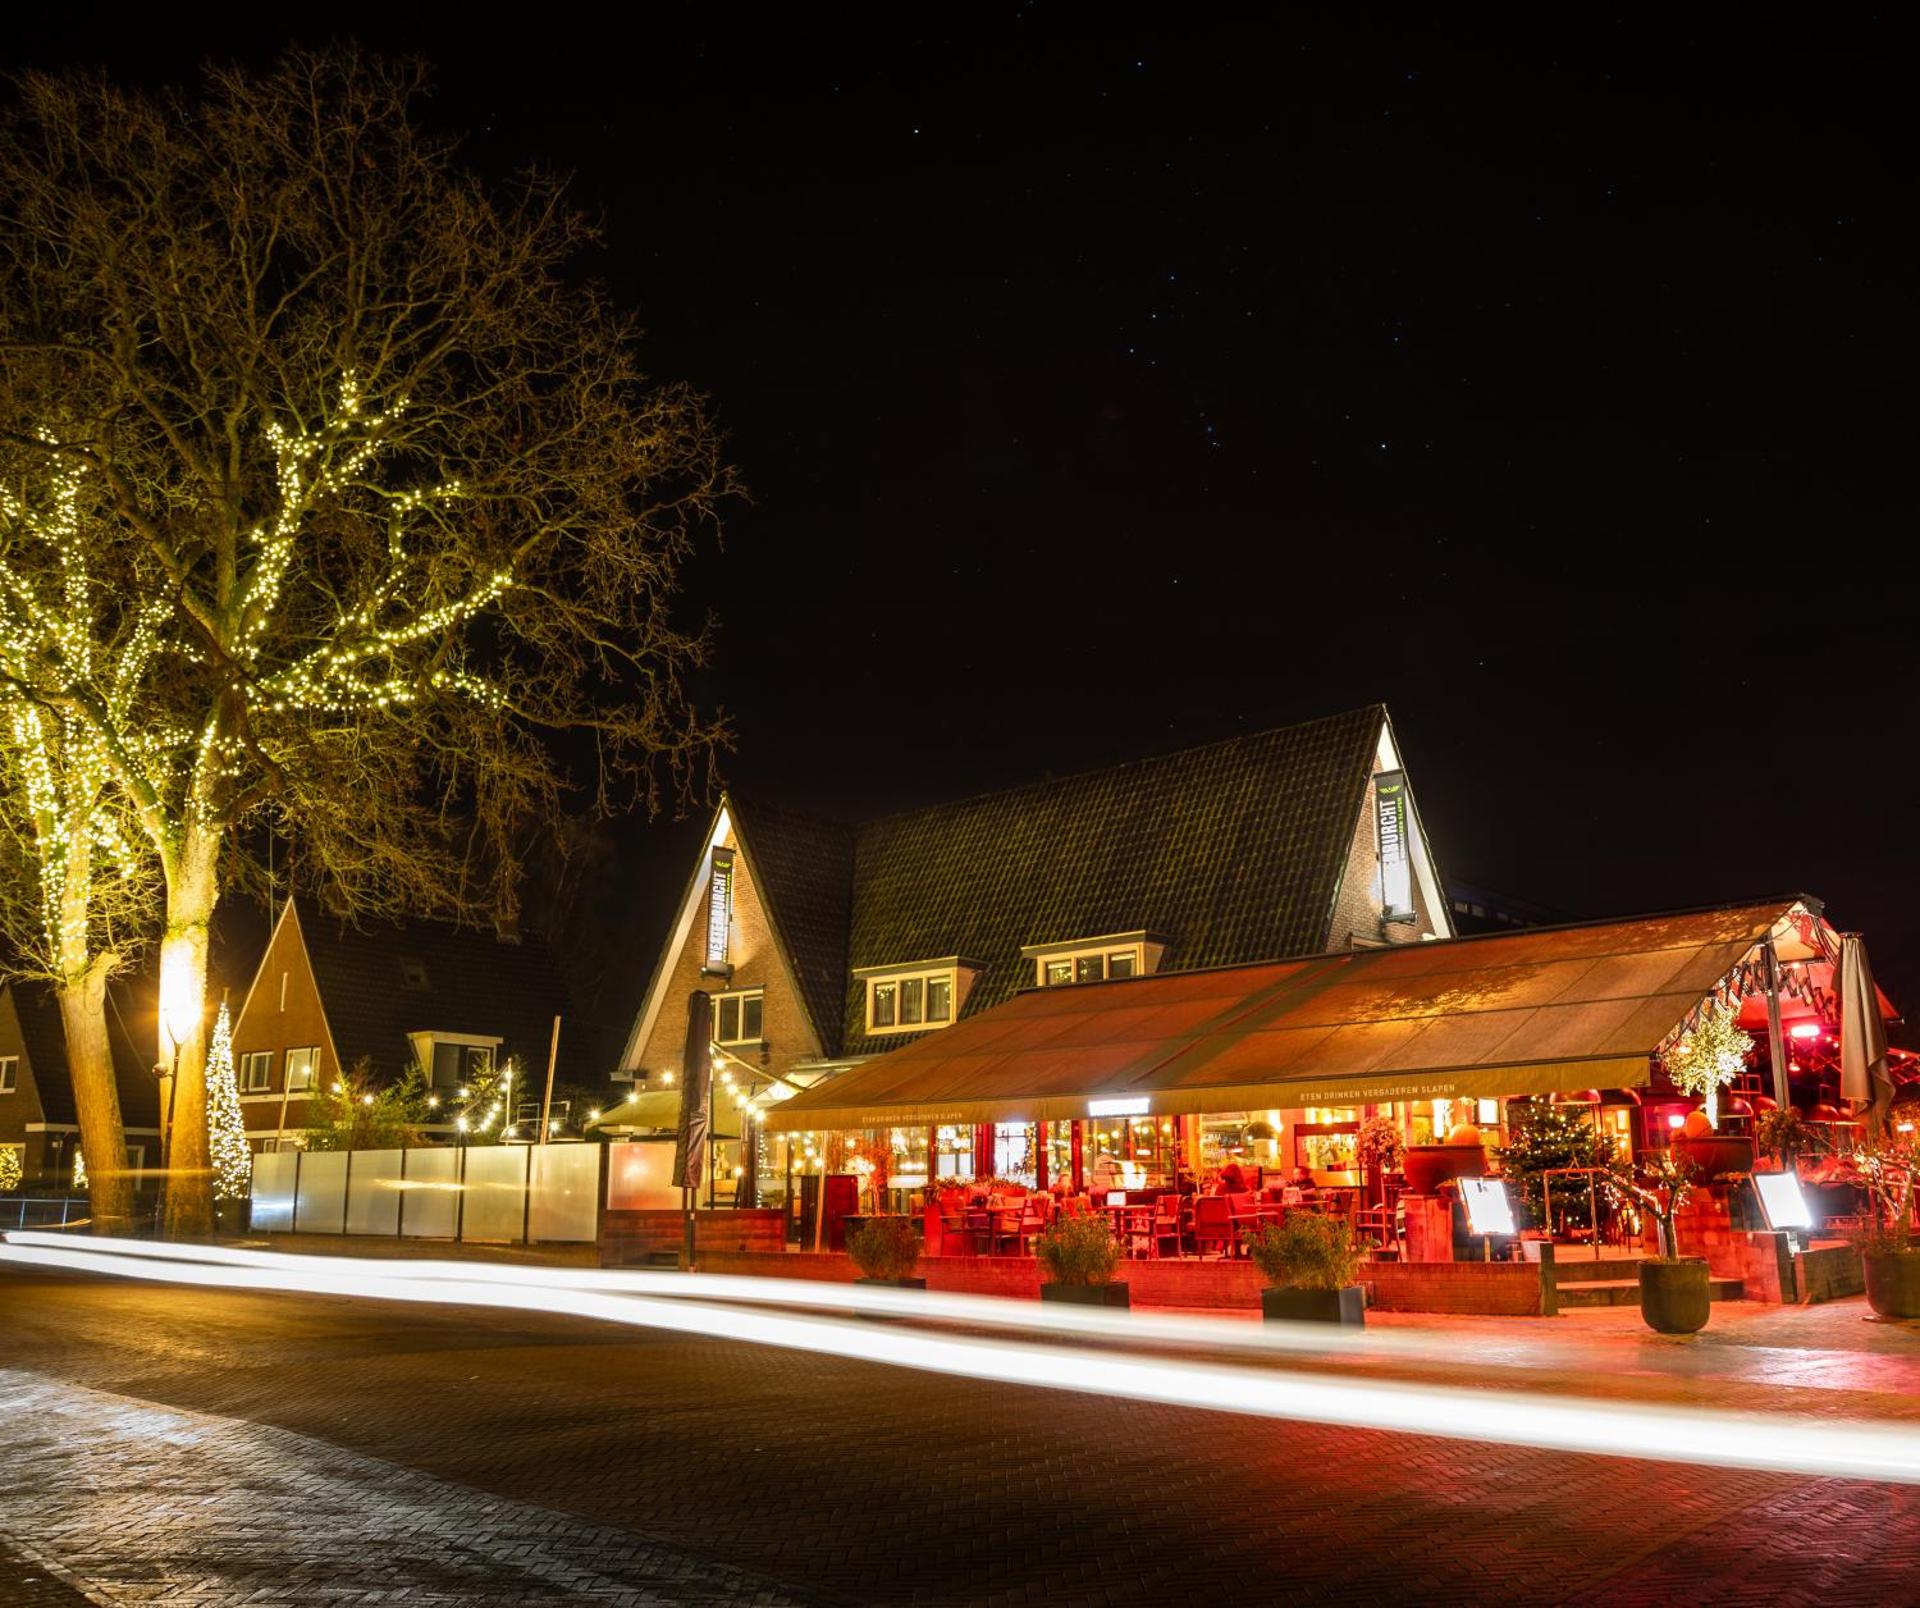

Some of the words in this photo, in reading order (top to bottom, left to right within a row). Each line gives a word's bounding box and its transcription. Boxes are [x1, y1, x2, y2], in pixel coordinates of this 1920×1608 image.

[1300, 1092, 1322, 1102] ETEN
[1324, 1090, 1360, 1100] DRINKEN
[1363, 1086, 1419, 1098] VERGADEREN
[1421, 1083, 1456, 1094] SLAPEN
